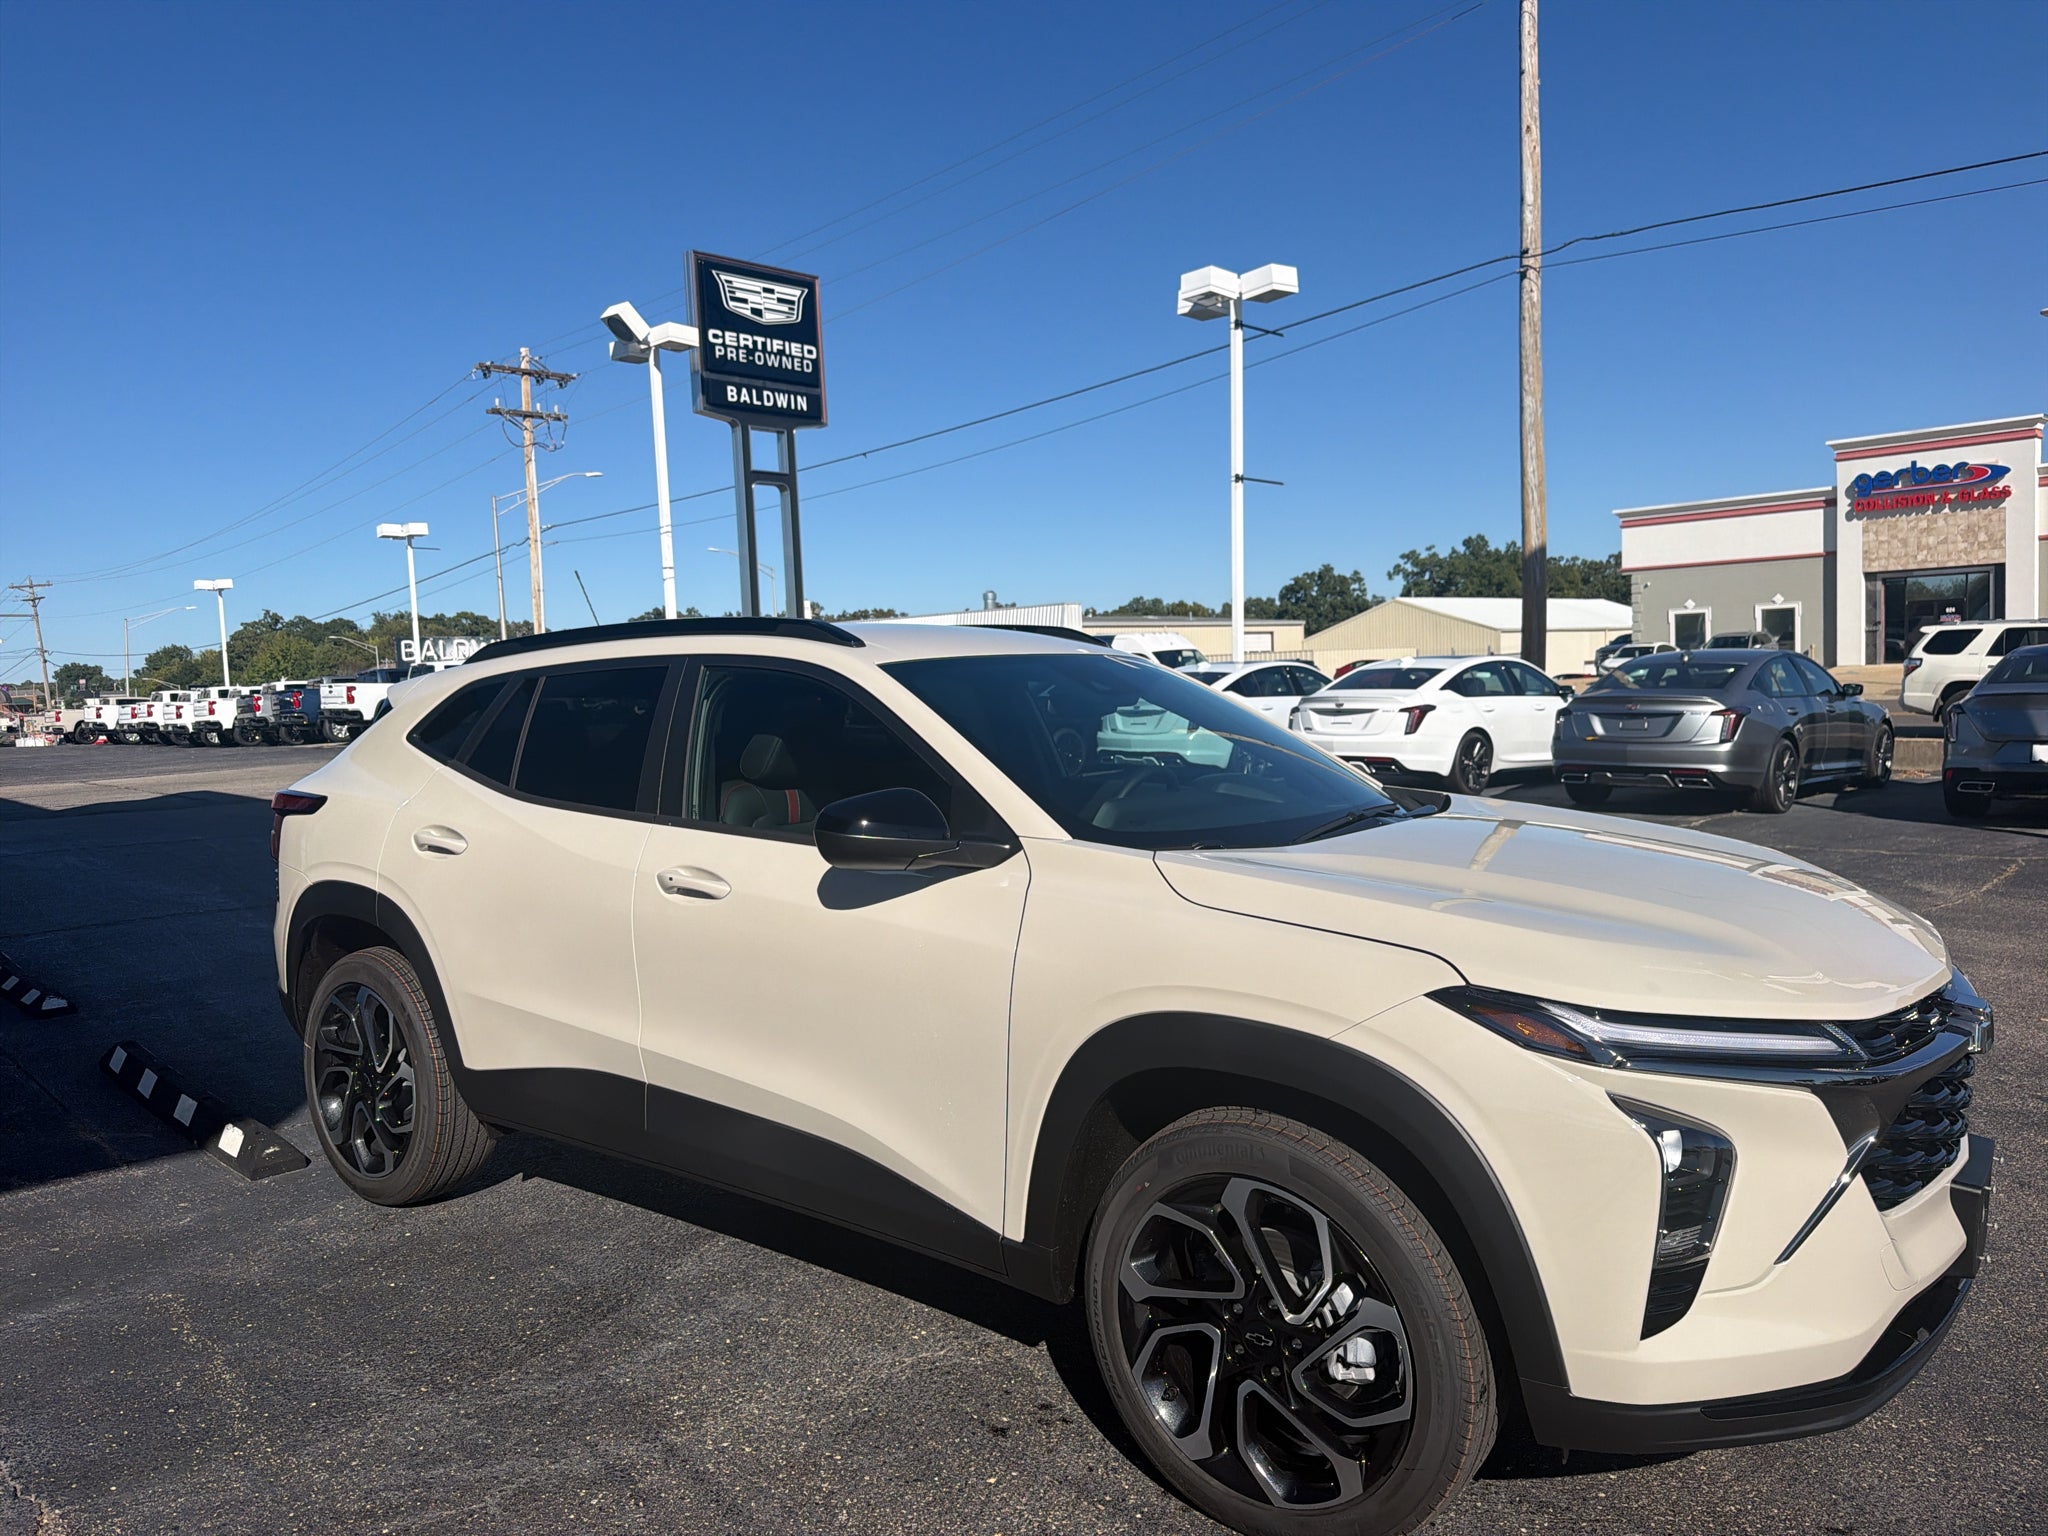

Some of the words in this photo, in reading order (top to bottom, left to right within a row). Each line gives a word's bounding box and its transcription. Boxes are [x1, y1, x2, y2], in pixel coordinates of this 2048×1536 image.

[708, 328, 817, 360] CERTIFIED
[715, 346, 813, 373] PRE-OWNED
[726, 385, 808, 412] BALDWIN
[1854, 460, 1970, 498] gerber
[1854, 492, 1936, 512] COLLISION
[1942, 492, 1953, 504] &
[1958, 485, 2012, 503] GLASS
[400, 639, 501, 661] BALD
